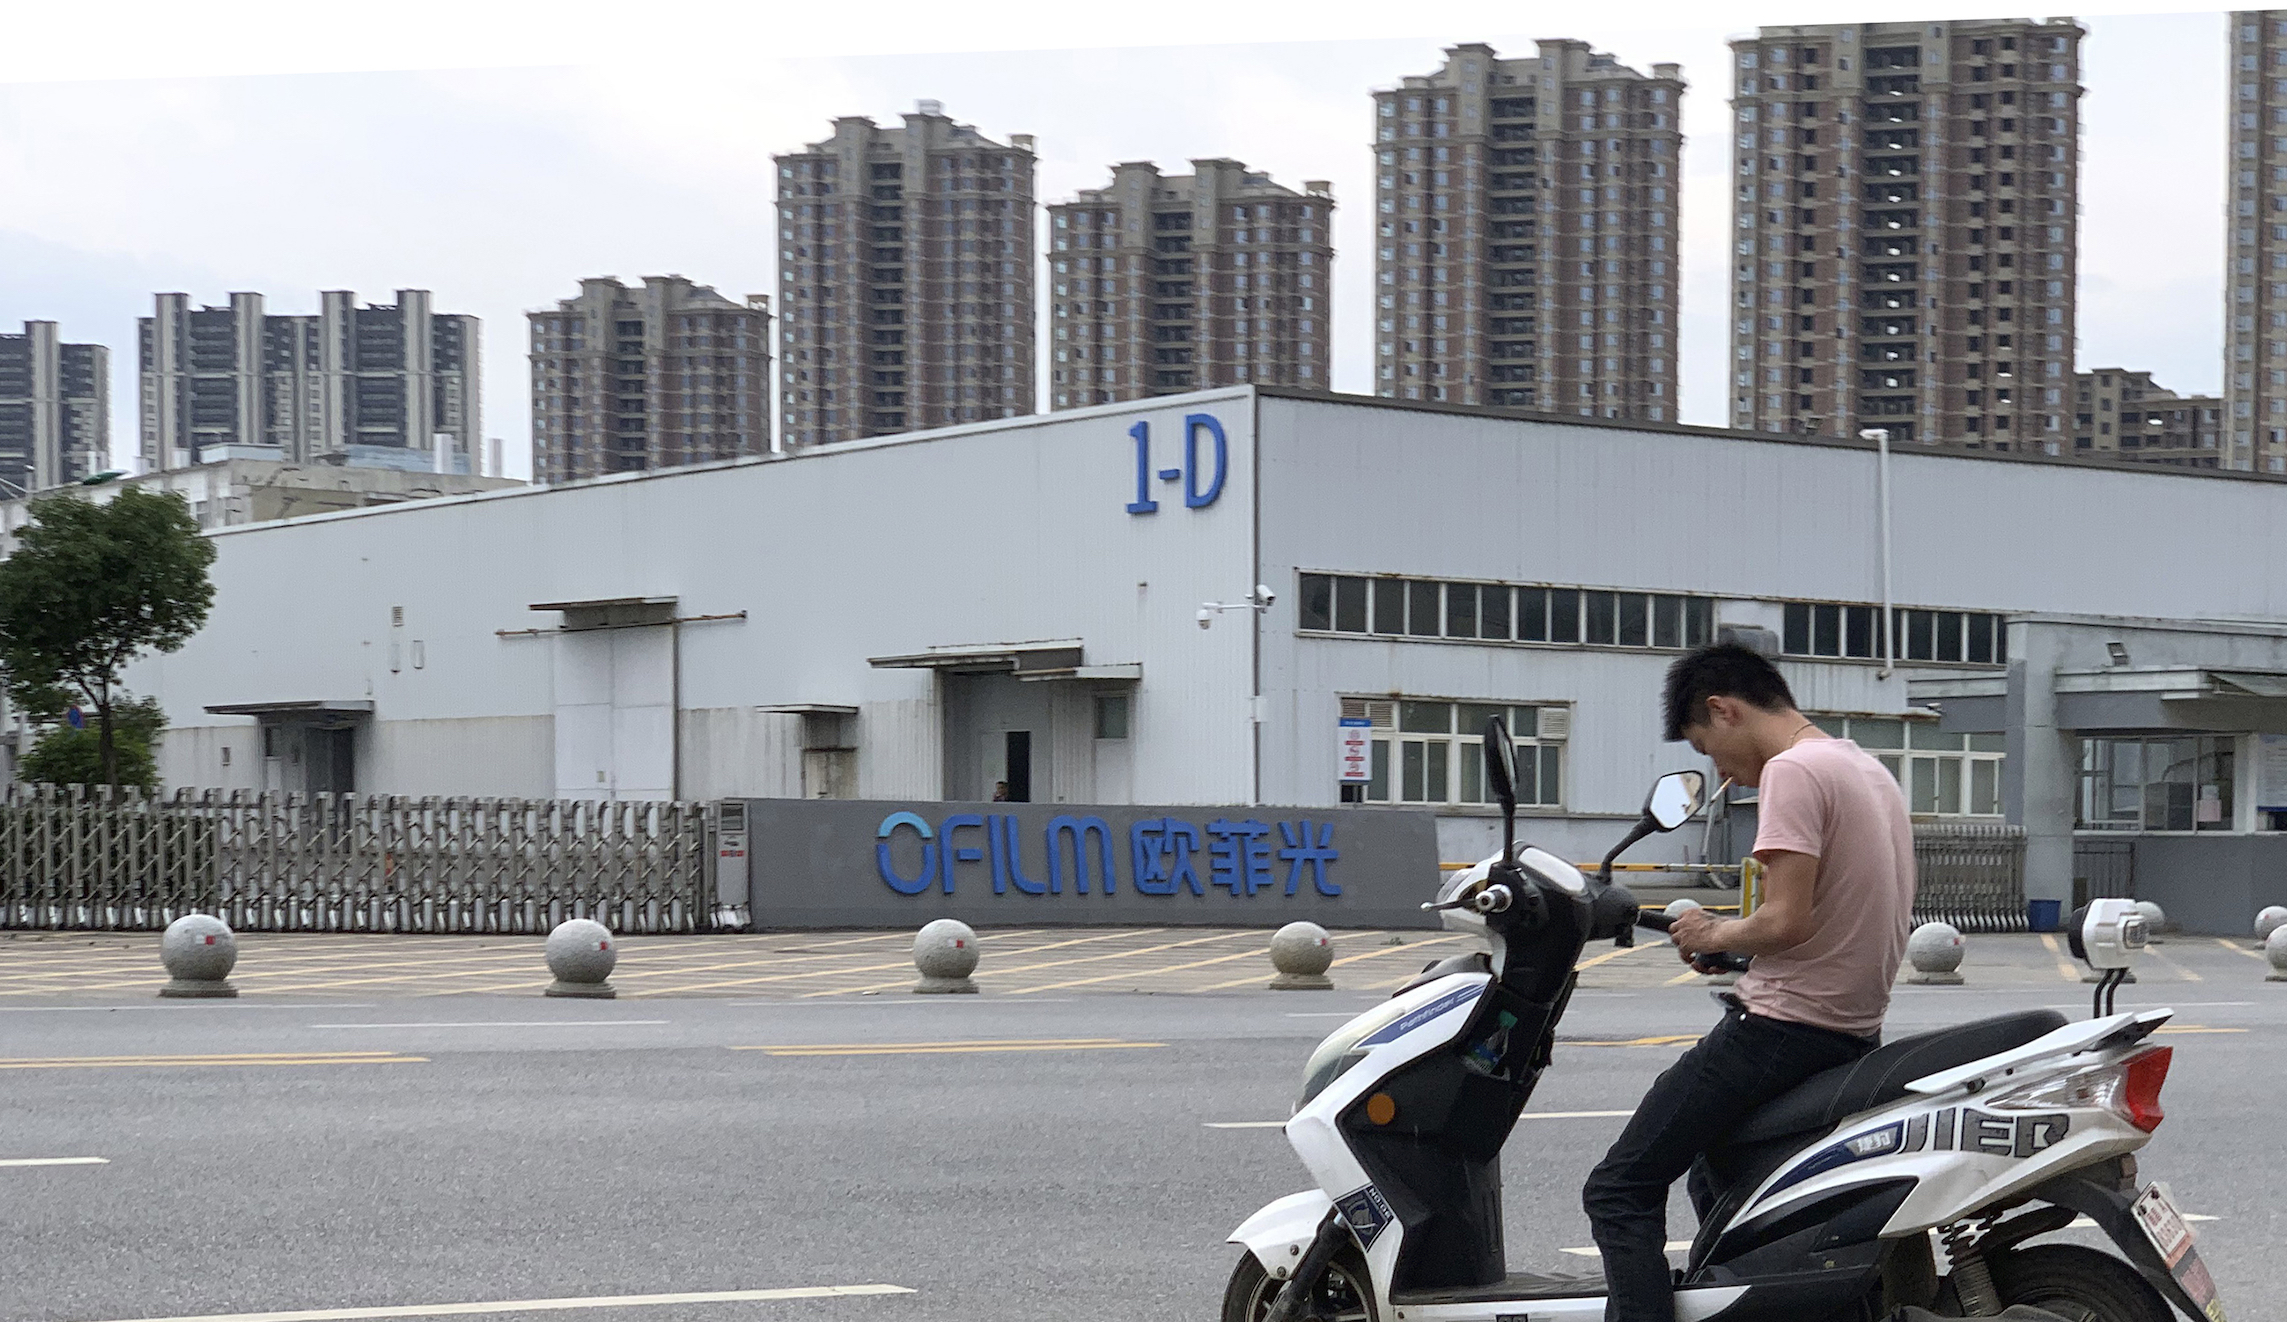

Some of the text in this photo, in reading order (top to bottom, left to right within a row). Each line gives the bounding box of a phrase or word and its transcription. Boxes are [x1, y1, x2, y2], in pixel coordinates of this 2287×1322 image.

[1126, 413, 1228, 515] 1-D
[876, 811, 1344, 896] OFILM 欧菲光
